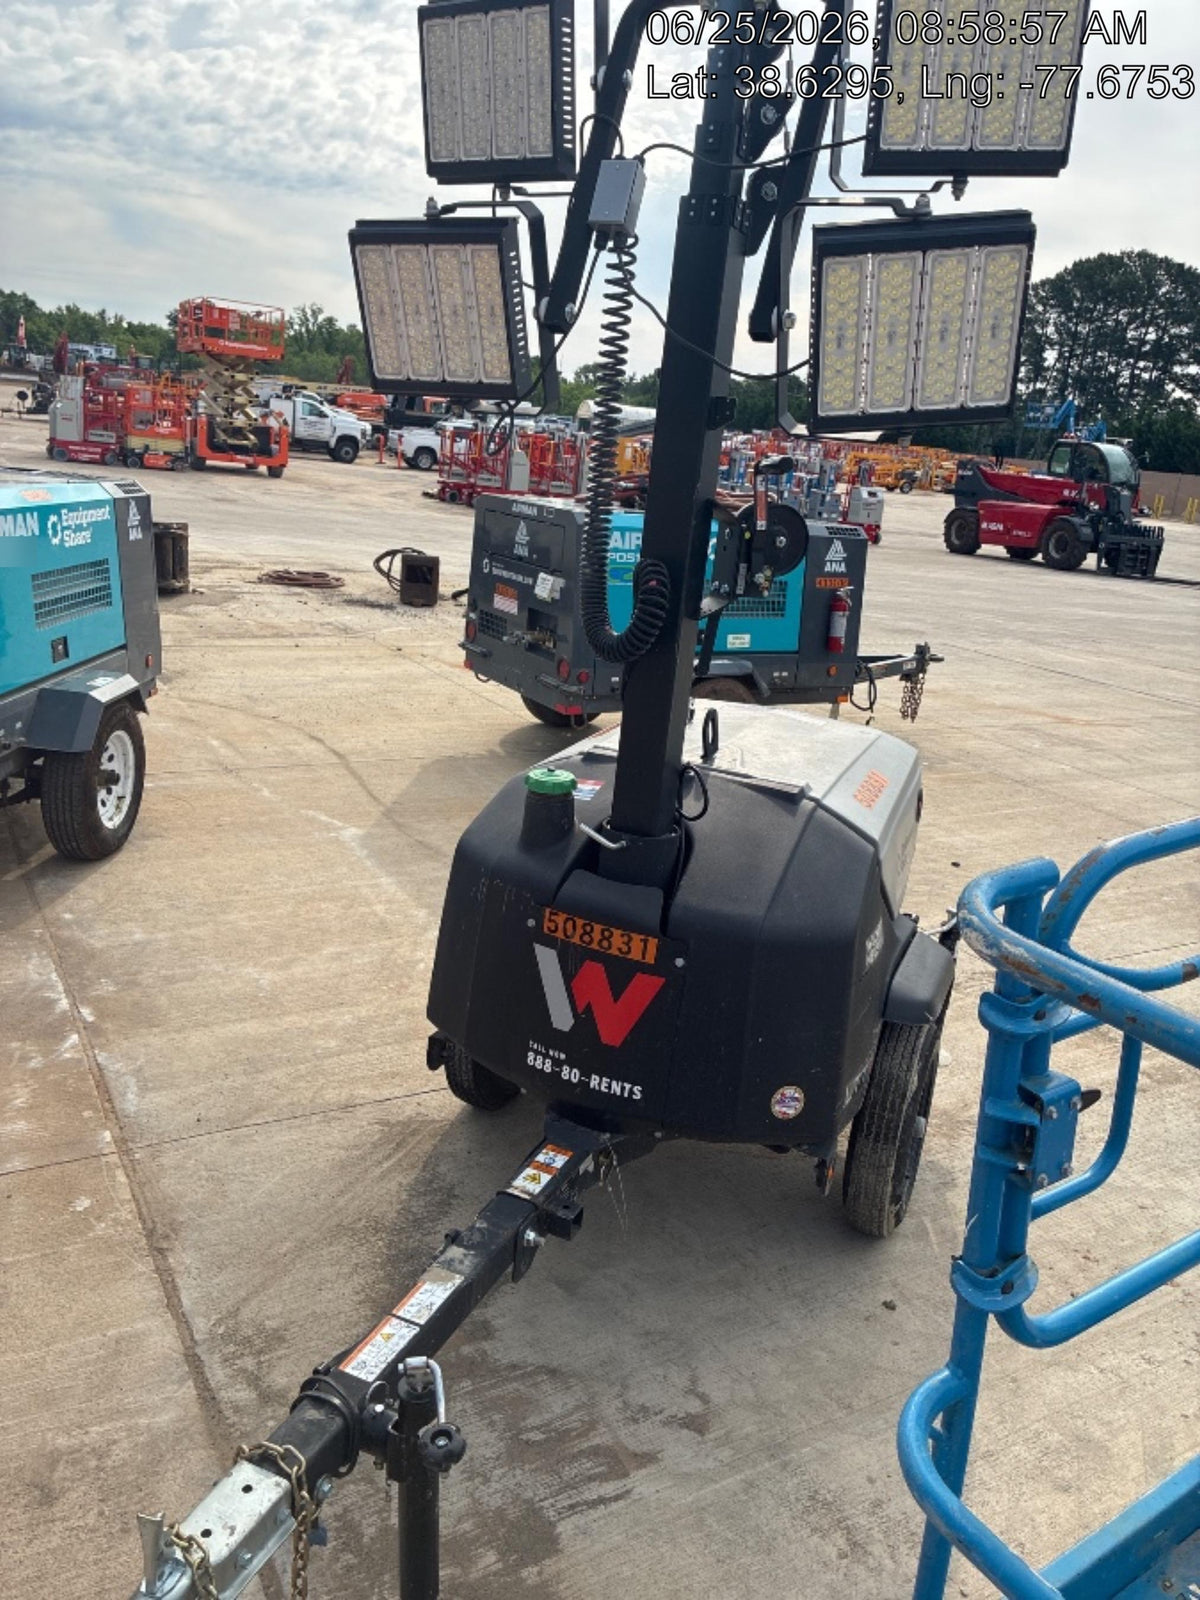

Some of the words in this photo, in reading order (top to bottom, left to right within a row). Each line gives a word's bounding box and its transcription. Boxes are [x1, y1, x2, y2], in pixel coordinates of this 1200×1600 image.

[61, 504, 111, 529] Equipment
[63, 531, 92, 547] Share
[824, 561, 847, 573] ANA
[546, 912, 651, 960] 508831
[527, 1051, 643, 1100] 888-80-RENTS
